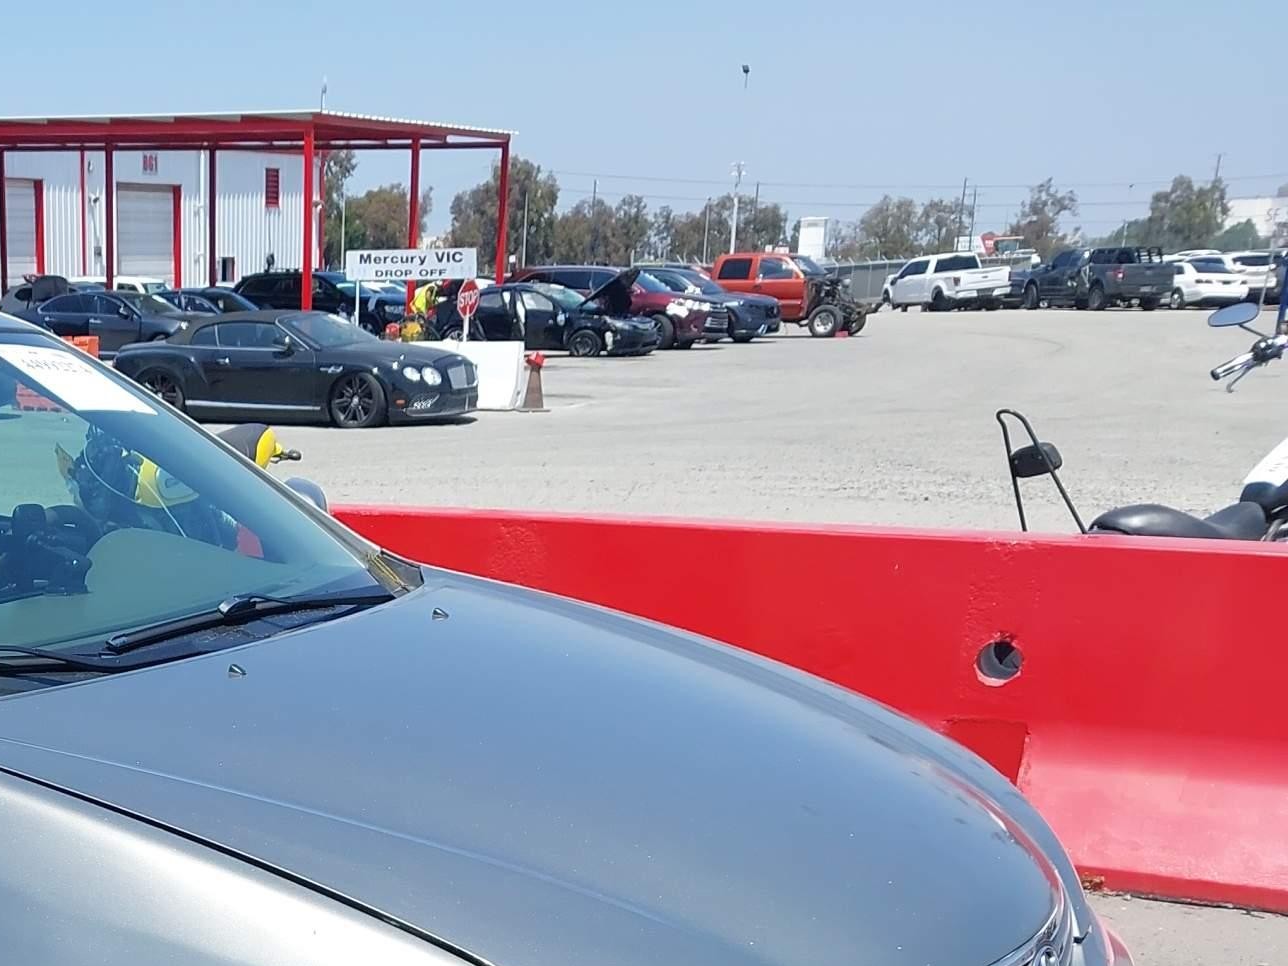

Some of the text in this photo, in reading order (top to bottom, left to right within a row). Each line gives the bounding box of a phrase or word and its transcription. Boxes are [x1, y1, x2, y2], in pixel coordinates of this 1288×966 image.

[359, 251, 464, 266] Mercury VIC
[374, 268, 448, 278] DROP OFF
[459, 289, 479, 308] STOP
